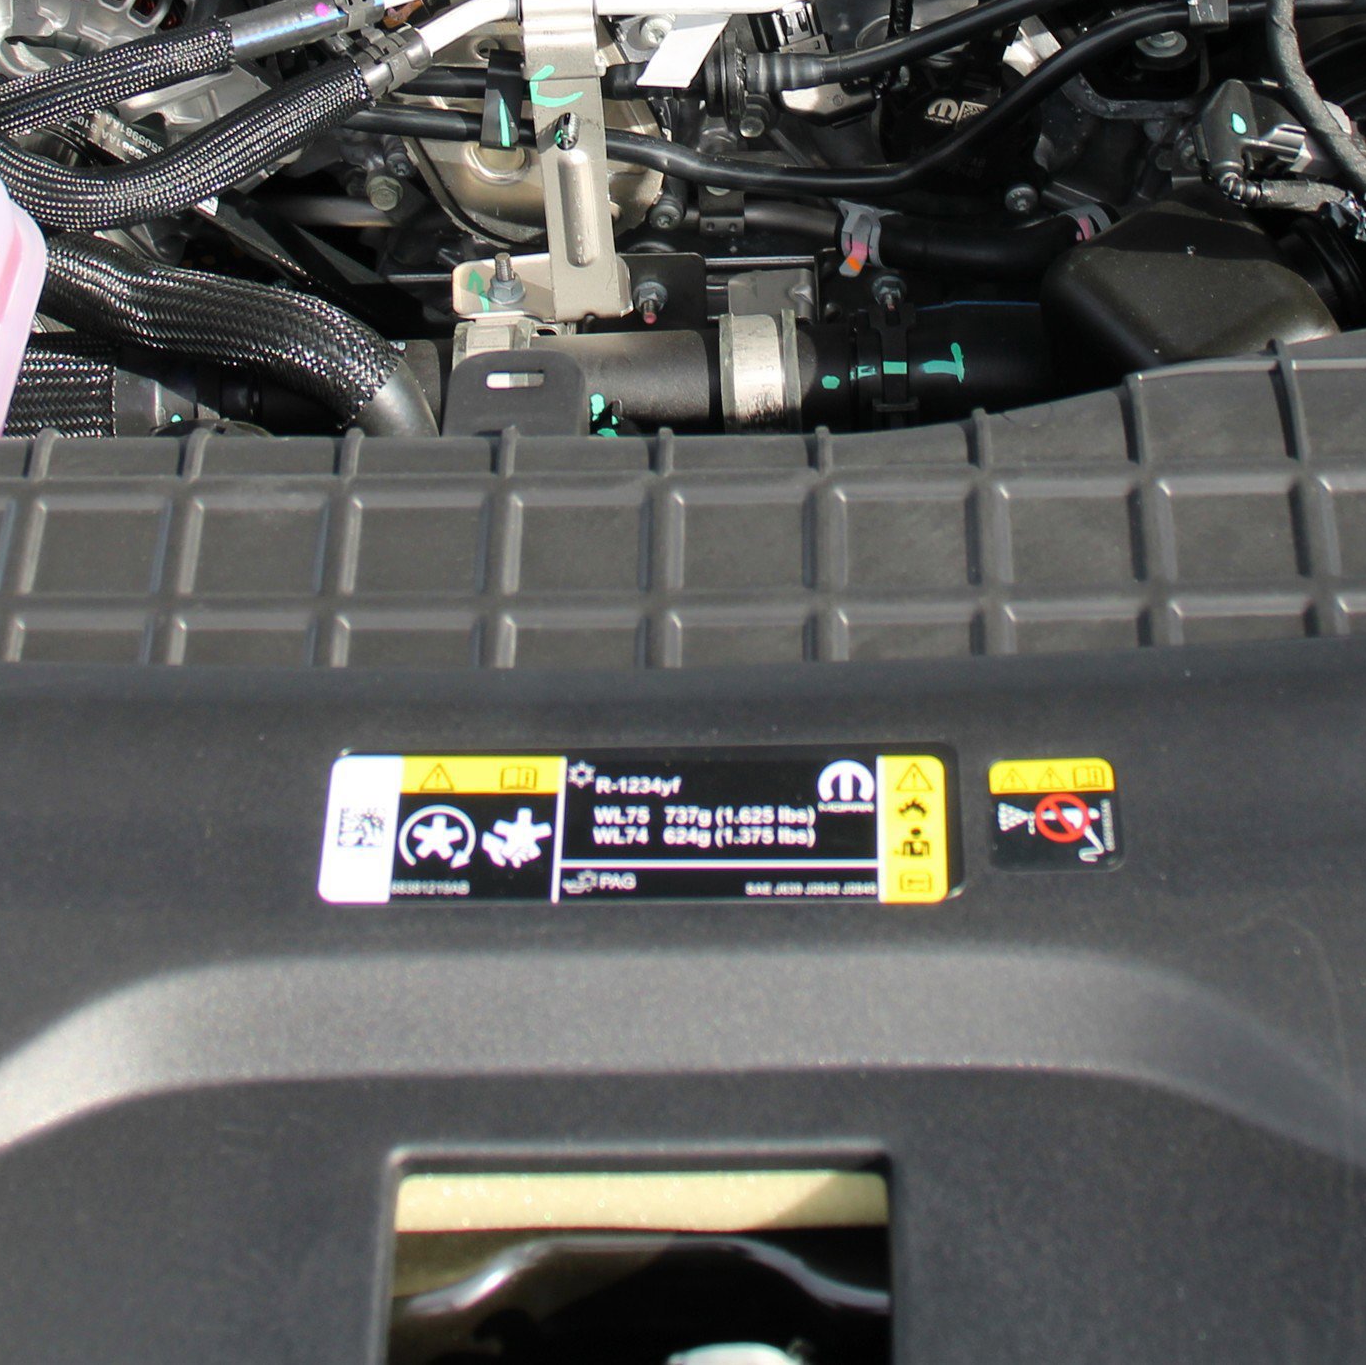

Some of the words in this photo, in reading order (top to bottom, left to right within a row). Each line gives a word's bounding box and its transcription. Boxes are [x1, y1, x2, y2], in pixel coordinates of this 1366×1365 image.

[594, 775, 682, 796] R-1234yf
[594, 805, 651, 826] WL75
[663, 805, 712, 829] 737g
[714, 805, 775, 828] (1.625
[777, 805, 817, 828] lbs)
[592, 826, 650, 846] WL74
[662, 826, 712, 849] 624g
[714, 826, 775, 848] (1.375
[777, 826, 817, 848] lbs)
[598, 871, 637, 891] PAG
